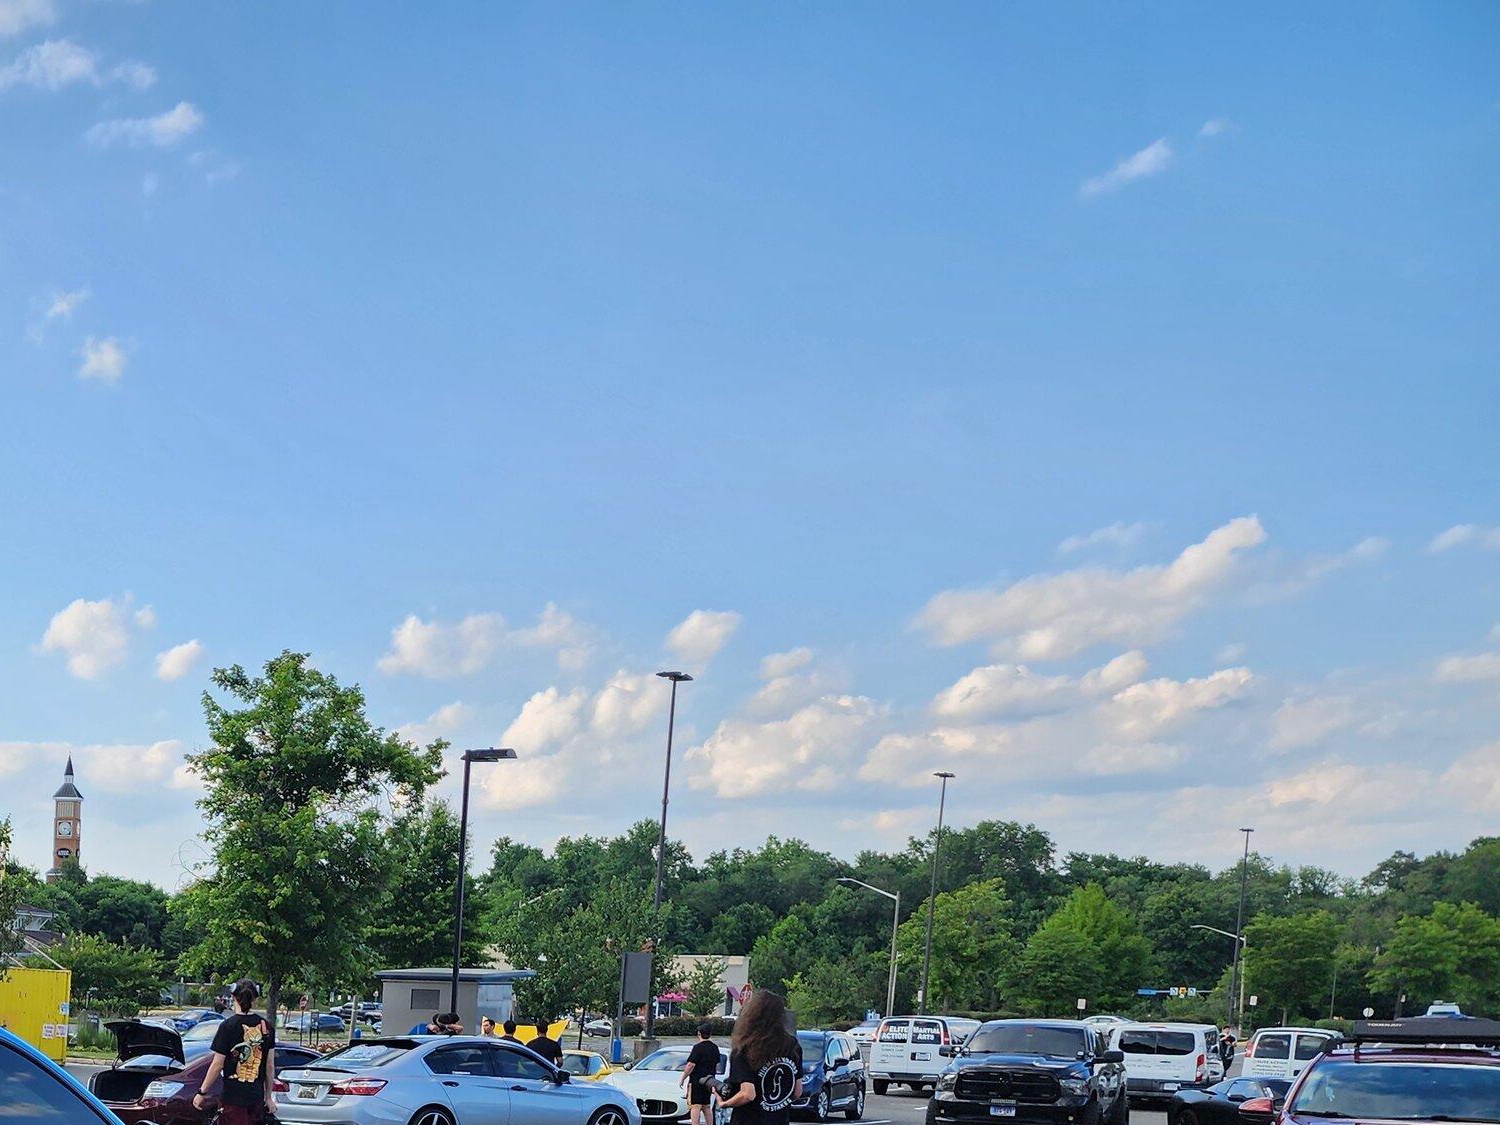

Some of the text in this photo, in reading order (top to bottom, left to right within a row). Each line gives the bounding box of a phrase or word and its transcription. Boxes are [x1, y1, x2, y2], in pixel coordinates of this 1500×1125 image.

[913, 1026, 941, 1034] MARTIAL
[881, 1032, 935, 1041] ACTION ARTS
